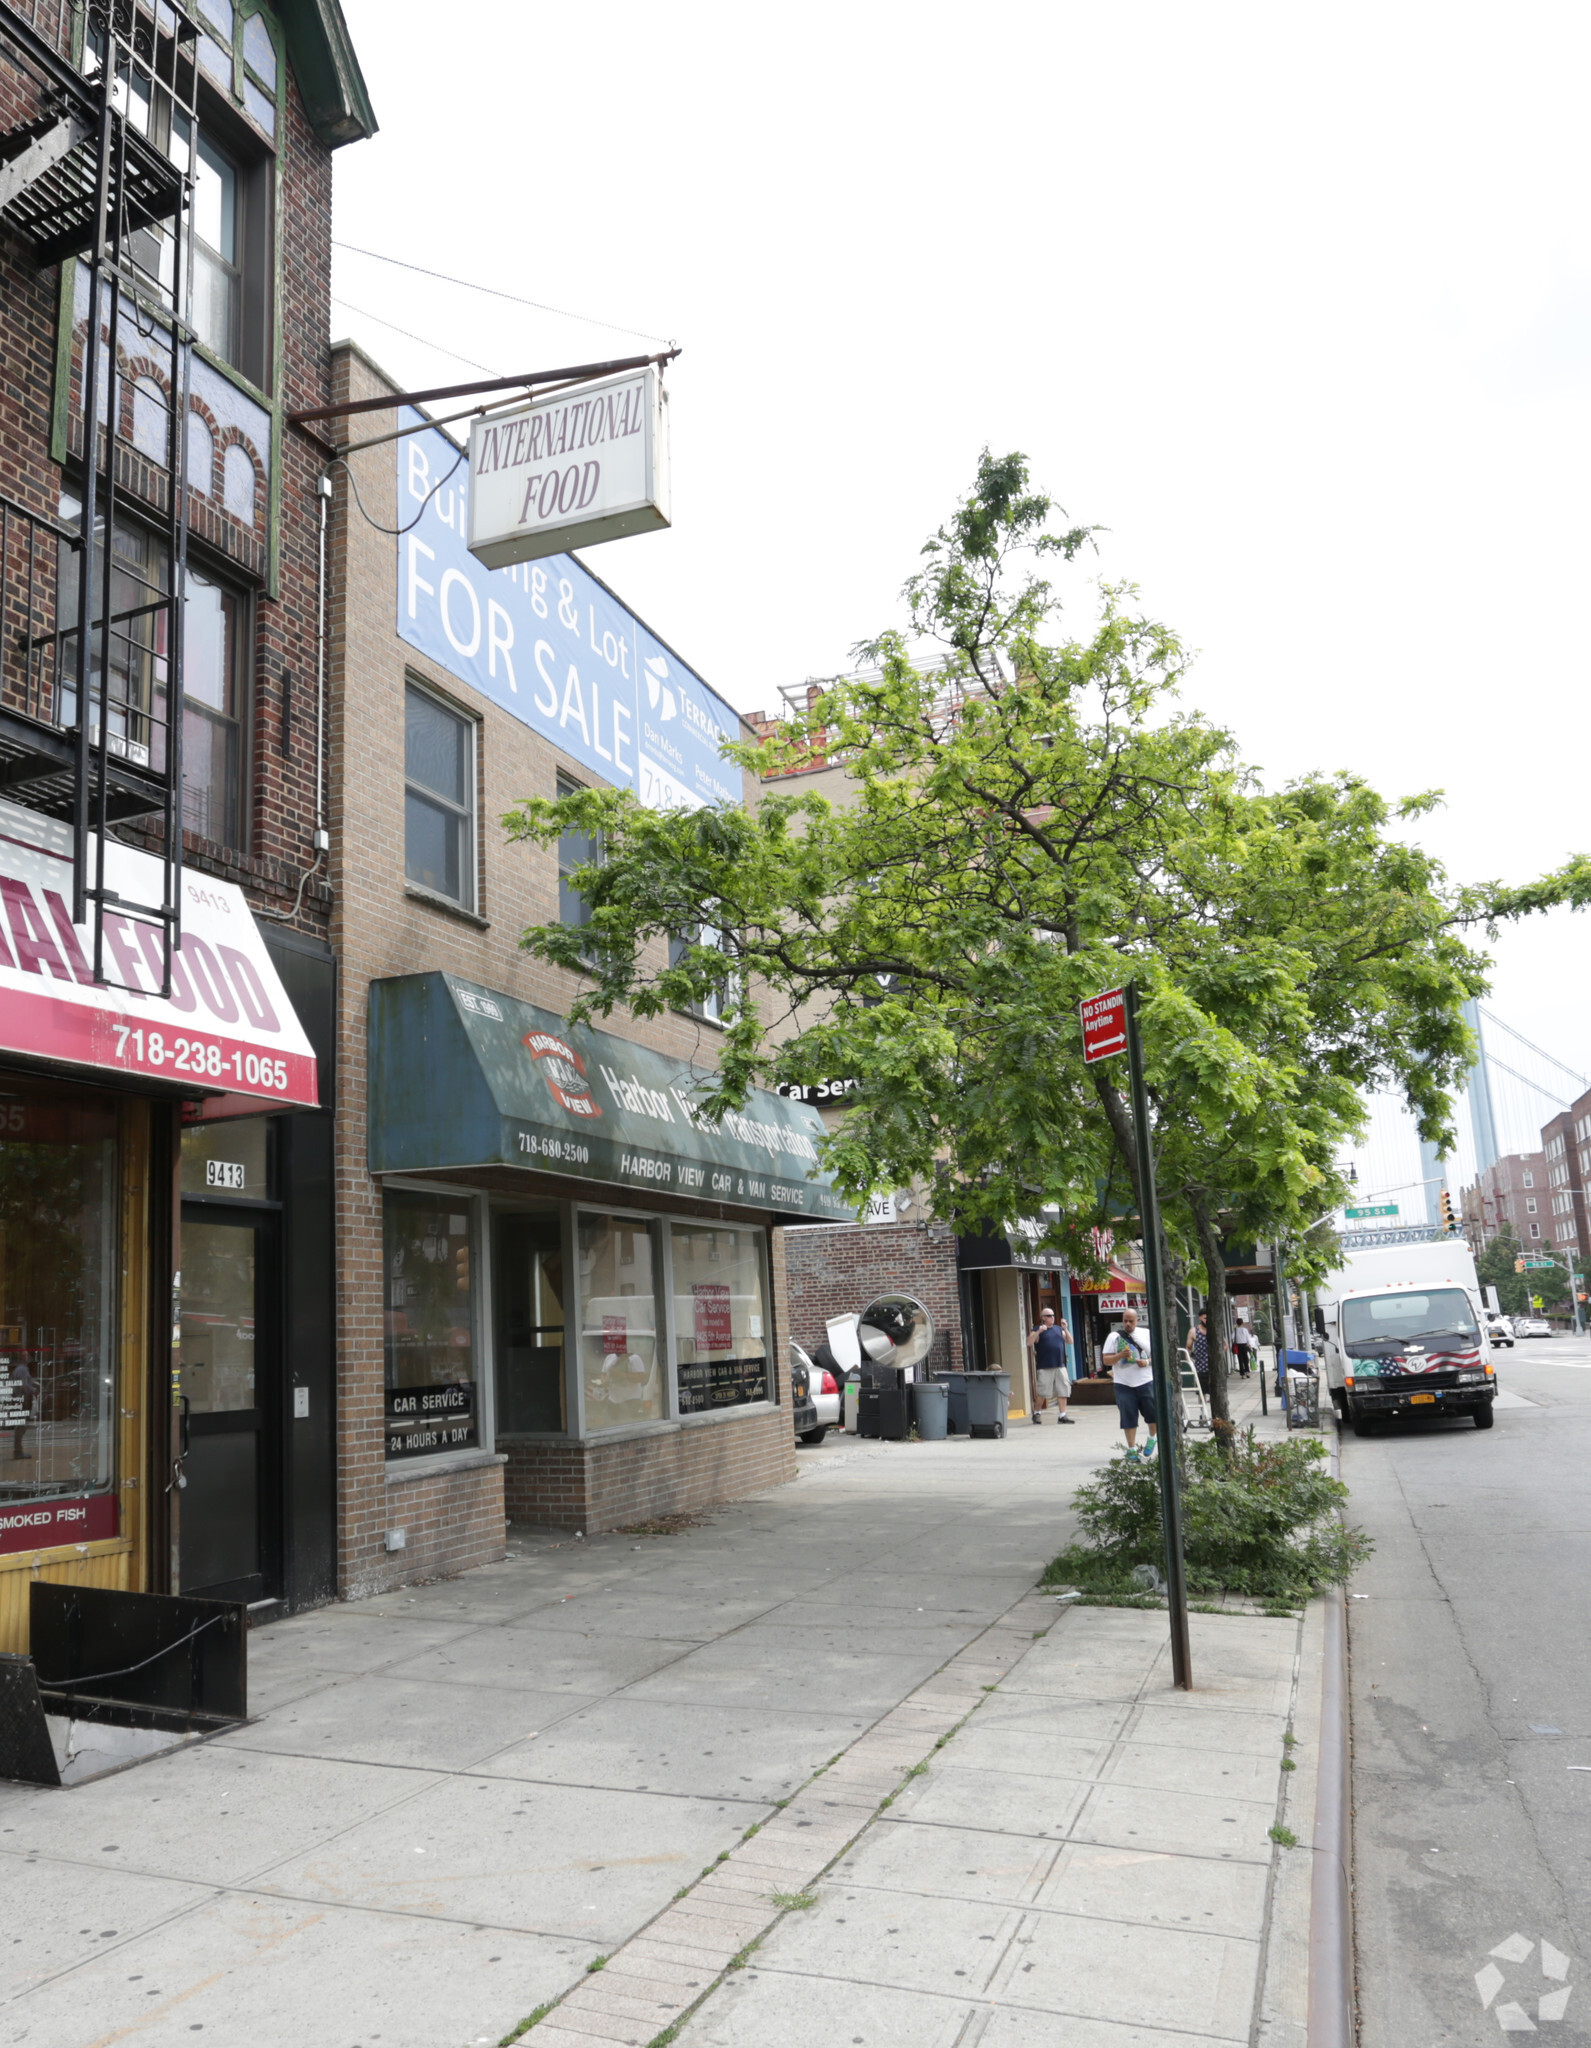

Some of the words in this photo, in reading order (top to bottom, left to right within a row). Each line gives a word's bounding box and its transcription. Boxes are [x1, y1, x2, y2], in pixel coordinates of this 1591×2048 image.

[477, 385, 643, 476] INTERNATIONAL
[518, 460, 600, 524] FOOD
[558, 578, 580, 639] &
[590, 603, 630, 680] Lot
[408, 532, 518, 694] FOR
[534, 639, 634, 778] SALE
[644, 722, 660, 745] Dan
[187, 885, 231, 914] 9413
[0, 875, 108, 991] AL
[103, 911, 281, 1033] FOOD
[1083, 1005, 1094, 1018] NO
[1094, 993, 1123, 1014] STANDIN
[1085, 1014, 1113, 1032] Anytime
[112, 1024, 288, 1090] 718-238-1065
[529, 1034, 575, 1063] HARBOR
[560, 1091, 593, 1114] VIEW
[599, 1064, 676, 1124] Harbor
[518, 1132, 589, 1164] 718-680-2500
[207, 1161, 243, 1188] 9413
[620, 1154, 671, 1182] HARBOR
[677, 1165, 705, 1187] VIEW
[712, 1173, 731, 1192] CAR
[737, 1178, 744, 1195] &
[748, 1180, 766, 1198] VAN
[771, 1185, 804, 1205] SERVICE
[866, 1201, 890, 1216] AVE
[1100, 1300, 1126, 1308] ATM
[683, 1369, 703, 1380] HARBOR
[704, 1368, 717, 1378] VIEW
[718, 1367, 727, 1377] CAR
[394, 1397, 416, 1412] CAR
[422, 1392, 464, 1410] SERVICE
[391, 1437, 402, 1451] 24
[406, 1431, 437, 1449] HOURS
[441, 1430, 448, 1444] A
[452, 1427, 468, 1442] DAY
[56, 1507, 86, 1522] FISH
